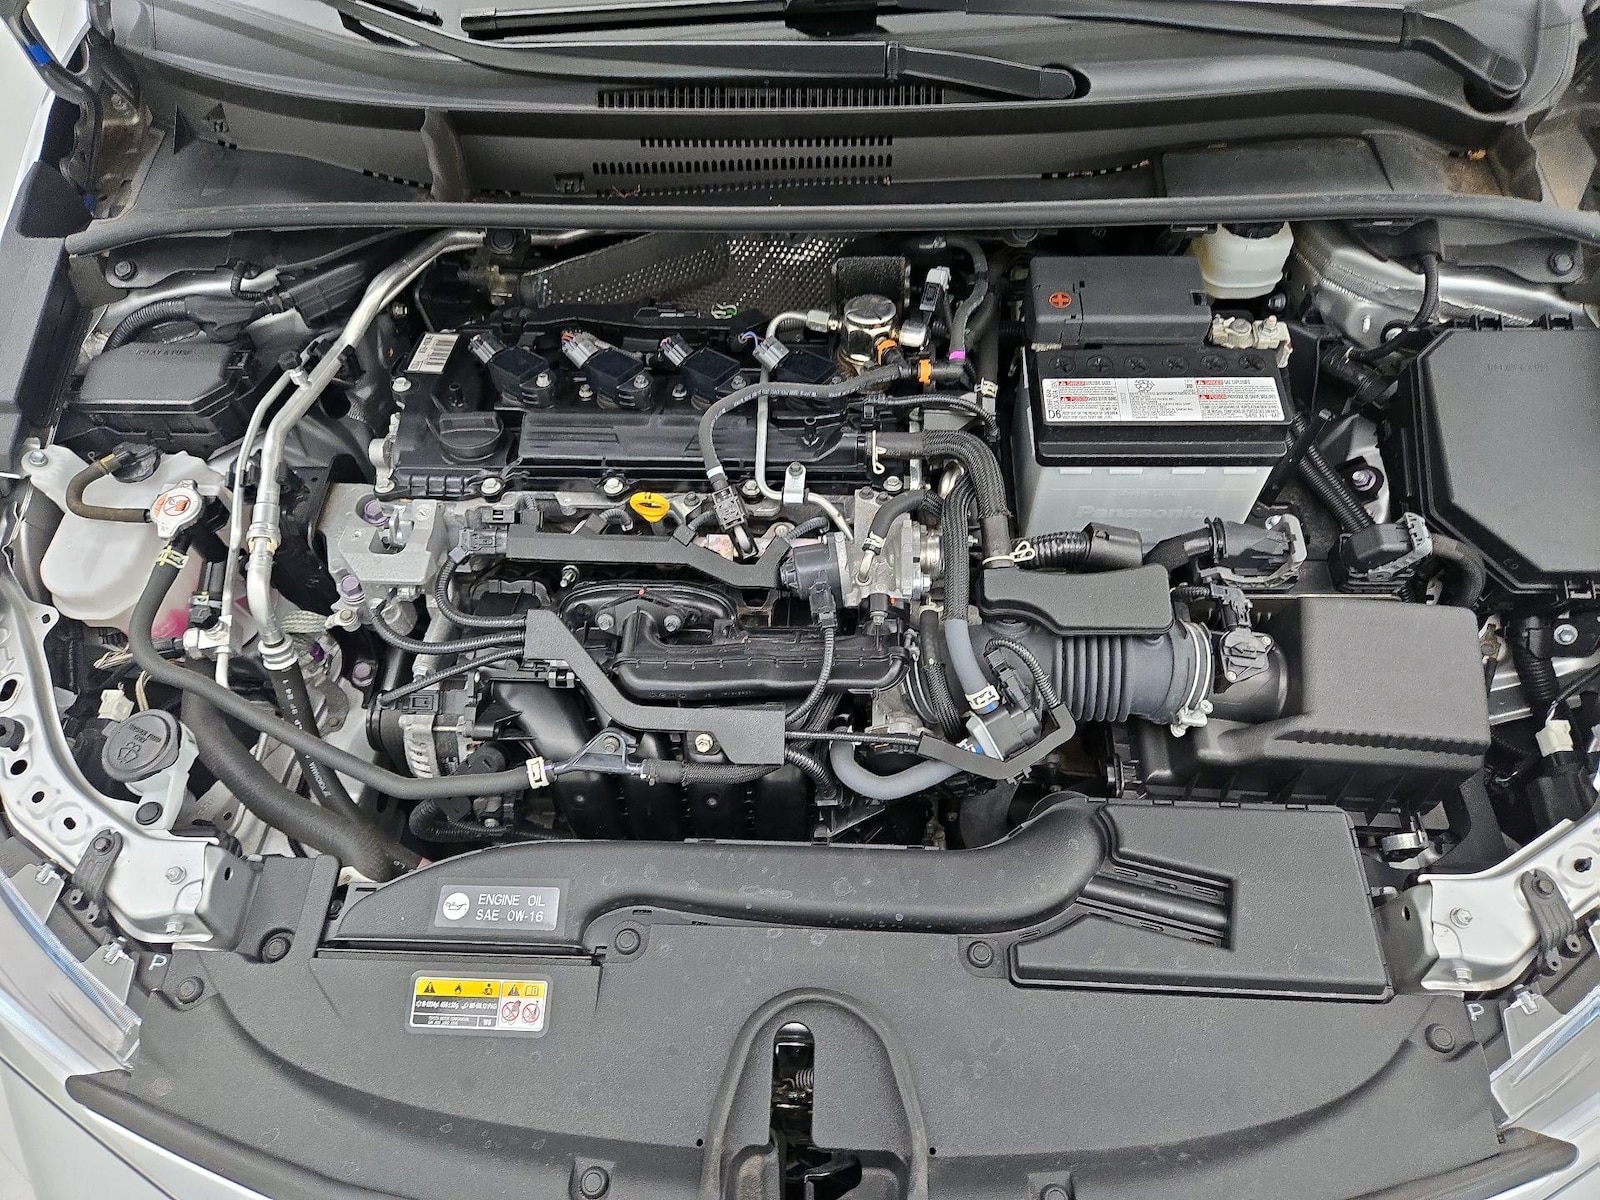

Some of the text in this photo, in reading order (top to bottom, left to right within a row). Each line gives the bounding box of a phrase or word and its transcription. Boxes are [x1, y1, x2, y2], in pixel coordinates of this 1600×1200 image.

[1048, 409, 1061, 419] D6
[1075, 505, 1205, 519] Panasonic
[478, 893, 546, 907] ENGINE OIL
[475, 908, 544, 923] SAE 0W-16
[148, 954, 167, 970] P
[1466, 1003, 1485, 1021] P
